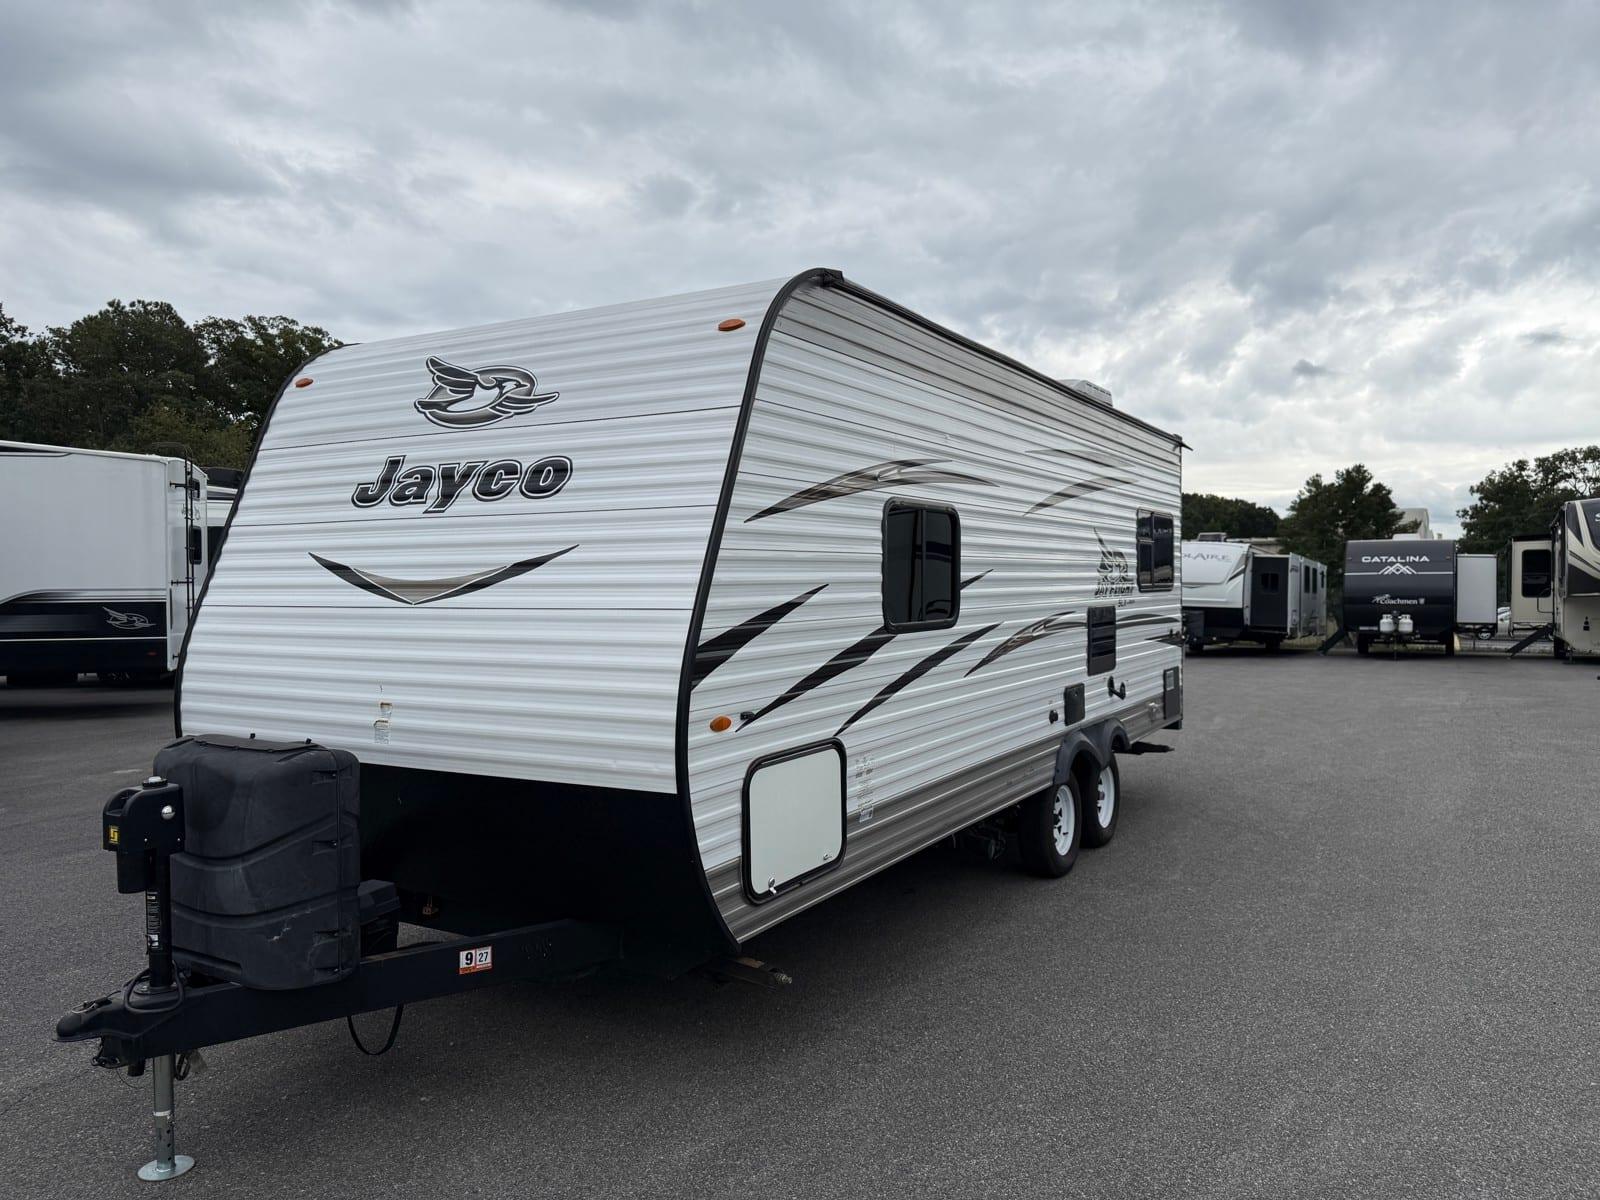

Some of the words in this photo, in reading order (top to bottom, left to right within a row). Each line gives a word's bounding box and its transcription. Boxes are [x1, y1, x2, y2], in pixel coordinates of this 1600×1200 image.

[351, 455, 573, 514] Jayco
[1361, 555, 1430, 563] CATALINA
[1380, 597, 1418, 605] Coachmen
[465, 952, 473, 966] 9
[478, 951, 489, 962] 27
